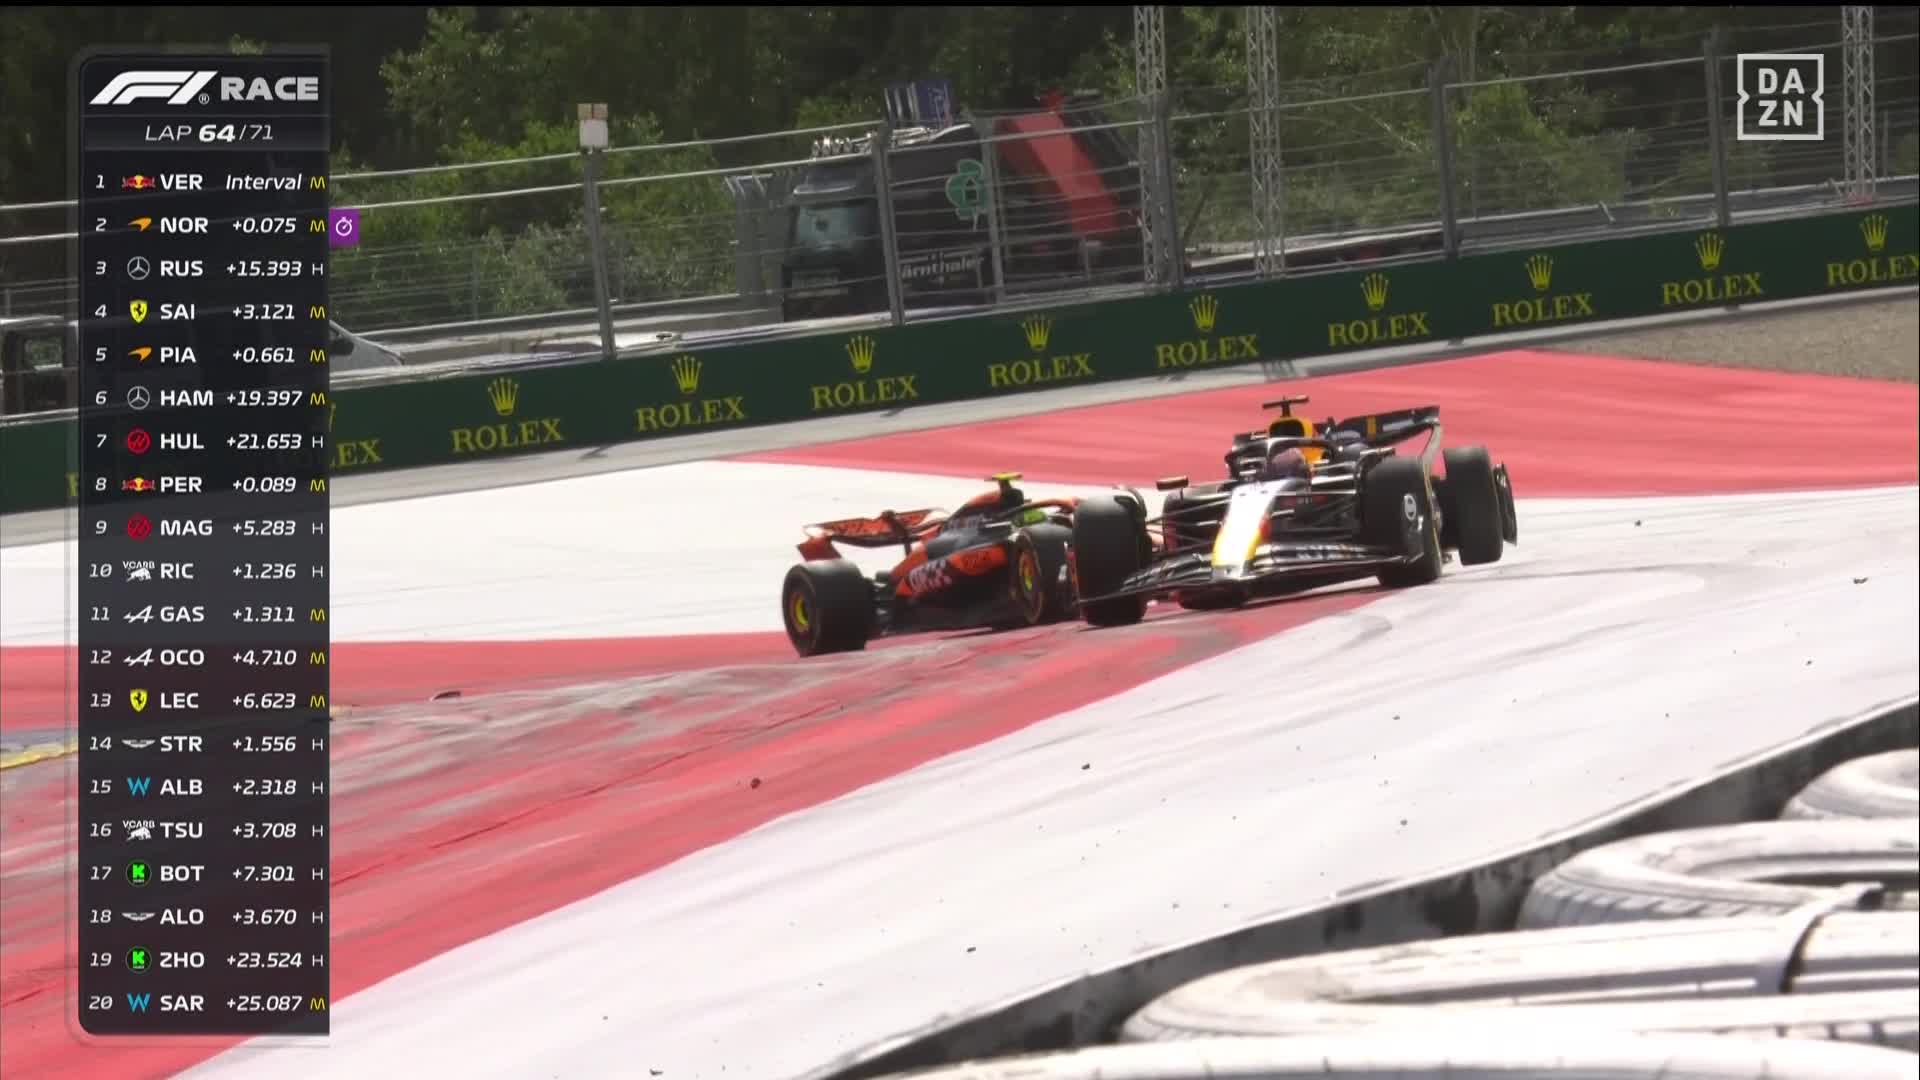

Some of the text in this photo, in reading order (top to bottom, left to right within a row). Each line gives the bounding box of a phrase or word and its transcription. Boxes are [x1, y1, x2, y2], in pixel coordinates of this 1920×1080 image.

[1662, 273, 1762, 306] ROLEX
[1493, 293, 1591, 325] ROLEX
[1327, 314, 1428, 346] ROLEX
[1157, 333, 1257, 369] ROLEX
[989, 353, 1090, 386] ROLEX
[813, 375, 917, 409] ROLEX
[637, 397, 743, 430] ROLEX
[452, 418, 563, 451] ROLEX
